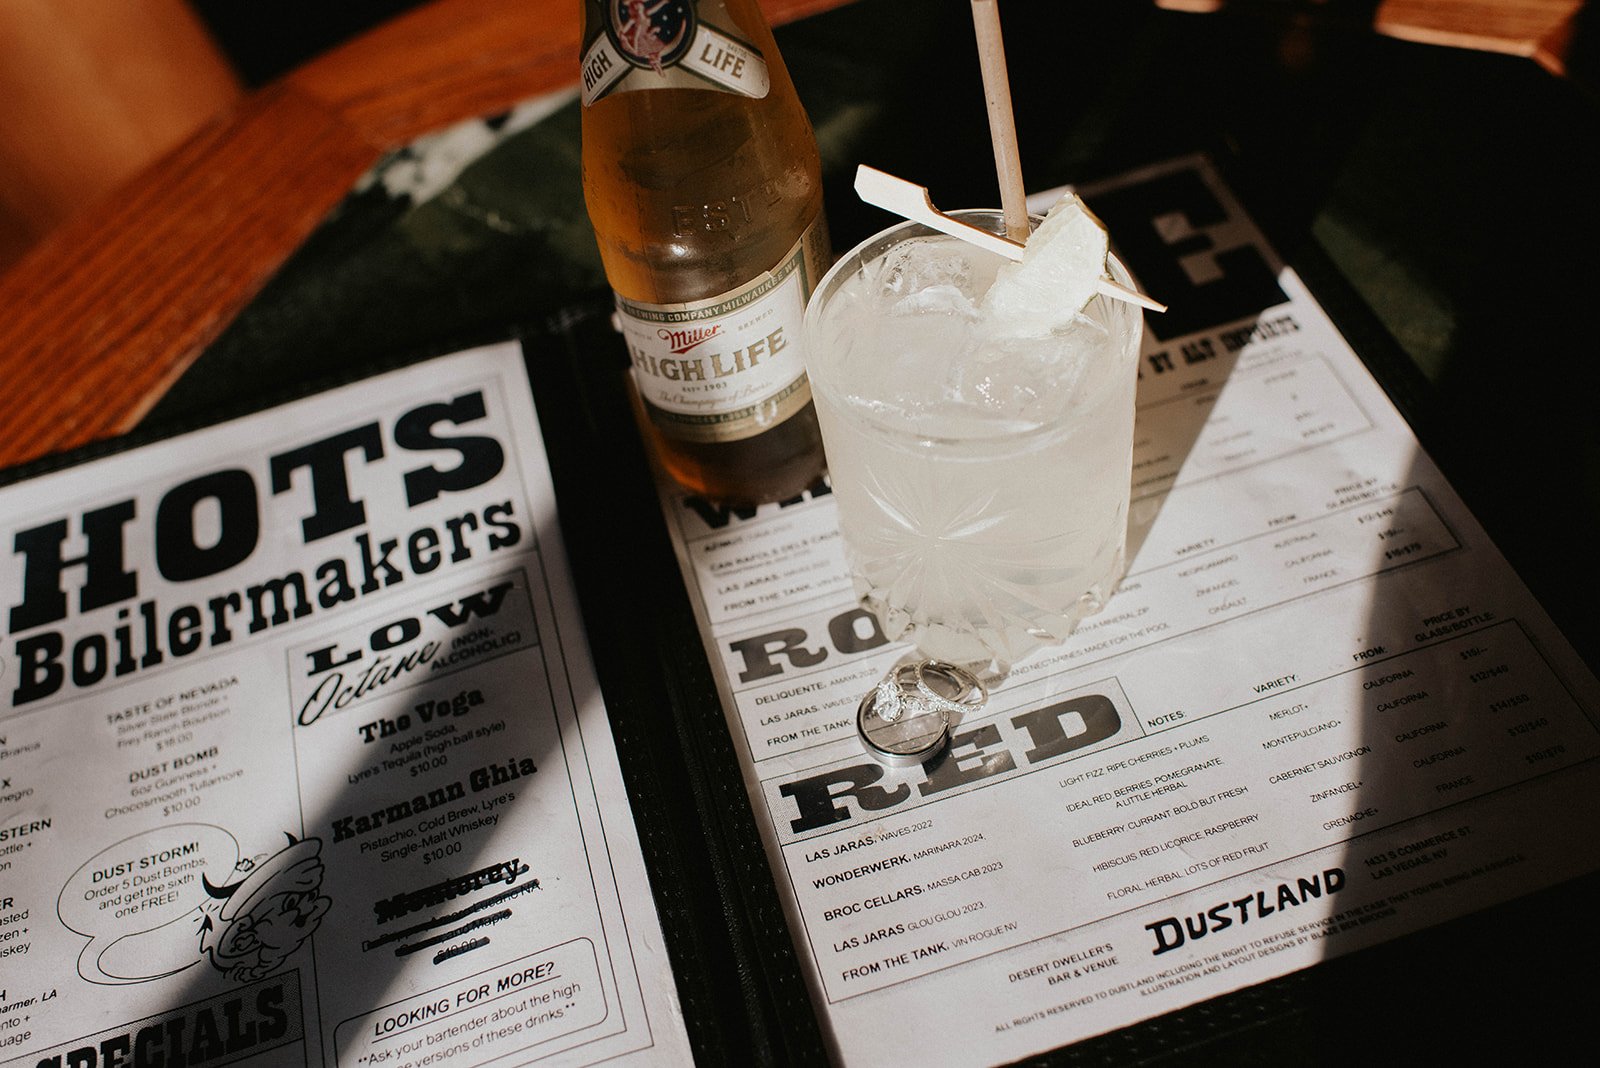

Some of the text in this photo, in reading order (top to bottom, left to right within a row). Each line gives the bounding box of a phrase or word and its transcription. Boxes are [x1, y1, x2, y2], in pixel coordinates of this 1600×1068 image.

[584, 50, 613, 91] HIGH
[700, 43, 746, 78] LIFE
[668, 306, 720, 322] COMPANY
[722, 271, 783, 311] MILWAUKEE
[633, 327, 789, 381] HIGH LIFE
[657, 324, 722, 350] Miller
[9, 390, 504, 634] HOTS
[12, 501, 521, 706] Boilermakers
[1423, 606, 1471, 627] PRICE BY
[306, 582, 514, 677] LOW
[432, 630, 521, 670] ALCOHOLIC)
[1352, 646, 1388, 661] FROM:
[298, 641, 442, 726] Octane
[1363, 669, 1416, 691] CALIFORNIA
[107, 704, 150, 725] TASTE
[179, 676, 239, 702] NEVADA
[358, 689, 485, 745] The Vega
[760, 713, 783, 727] LAS
[1147, 710, 1187, 728] NOTES:
[1377, 690, 1429, 713] CALIFORNIA
[389, 733, 424, 754] Apple
[766, 727, 823, 748] FROM THE
[1395, 721, 1448, 743] CALIFORNIA
[129, 747, 219, 784] DUST BOMB
[348, 720, 506, 785] Lyre's Tequila (high ball style)
[410, 756, 448, 778] $10.00
[779, 694, 1122, 834] RED
[1059, 775, 1086, 789] LIGHT
[1107, 761, 1128, 773] RIPE
[1128, 745, 1174, 767] CHERRIES
[1179, 735, 1210, 750] PLUMS
[1269, 745, 1372, 785] CABERNET SAUVIGNON
[1413, 745, 1468, 769] CALIFORNIA
[105, 769, 244, 819] Chocosmooth Tullamore
[156, 767, 209, 790] Guinness
[1116, 780, 1188, 809] A LITTLE HERBAL
[1435, 774, 1474, 794] FRANCE
[331, 757, 538, 844] Karmann Ghia
[418, 815, 446, 833] Cold
[482, 792, 516, 812] Lyre's
[1066, 798, 1093, 814] IDEAL
[1173, 801, 1199, 816] BOLD
[1199, 796, 1217, 807] BUT
[1218, 785, 1249, 802] FRESH
[381, 813, 500, 863] Single-Malt Whiskey
[423, 842, 462, 865] $10.00
[805, 848, 831, 863] LAS
[879, 826, 912, 842] WAVES
[911, 820, 934, 833] 2022
[913, 839, 962, 860] MARINARA
[1139, 846, 1160, 857] RED
[1203, 814, 1260, 837] RASPBERRY
[1363, 830, 1458, 868] 1433 S COMMERCE
[92, 842, 200, 884] DUST STORM!
[1184, 861, 1209, 876] LOTS
[1209, 857, 1222, 868] OF
[1222, 850, 1243, 863] RED
[1242, 841, 1270, 856] FRUIT
[1370, 867, 1393, 881] LAS
[1431, 849, 1449, 862] NV
[84, 882, 120, 901] Order
[122, 879, 131, 890] 5
[133, 871, 162, 887] Dust
[98, 872, 195, 911] and get the sixth
[114, 890, 180, 919] one FREE!
[824, 903, 862, 922] BROC
[927, 875, 961, 891] MASSA
[961, 868, 982, 881] CAB
[982, 861, 1004, 875] 2023
[833, 908, 963, 953] LAS JARAS GLOU GLOU
[1144, 866, 1346, 957] DUSTLAND
[842, 962, 881, 982] FROM
[884, 953, 910, 969] THE
[951, 935, 970, 949] VIN
[968, 926, 1004, 944] ROGUE
[1003, 921, 1018, 933] NV
[1008, 943, 1114, 983] DESERT DWELLER'S
[1047, 956, 1120, 986] BAR & VENUE
[374, 961, 555, 1036] LOOKING FOR MORE?
[1012, 960, 1203, 1027] RIGHTS RESERVED DUSTLAND INCLUDING
[396, 982, 581, 1060] your bartender about the high
[416, 1023, 522, 1068] versions of these
